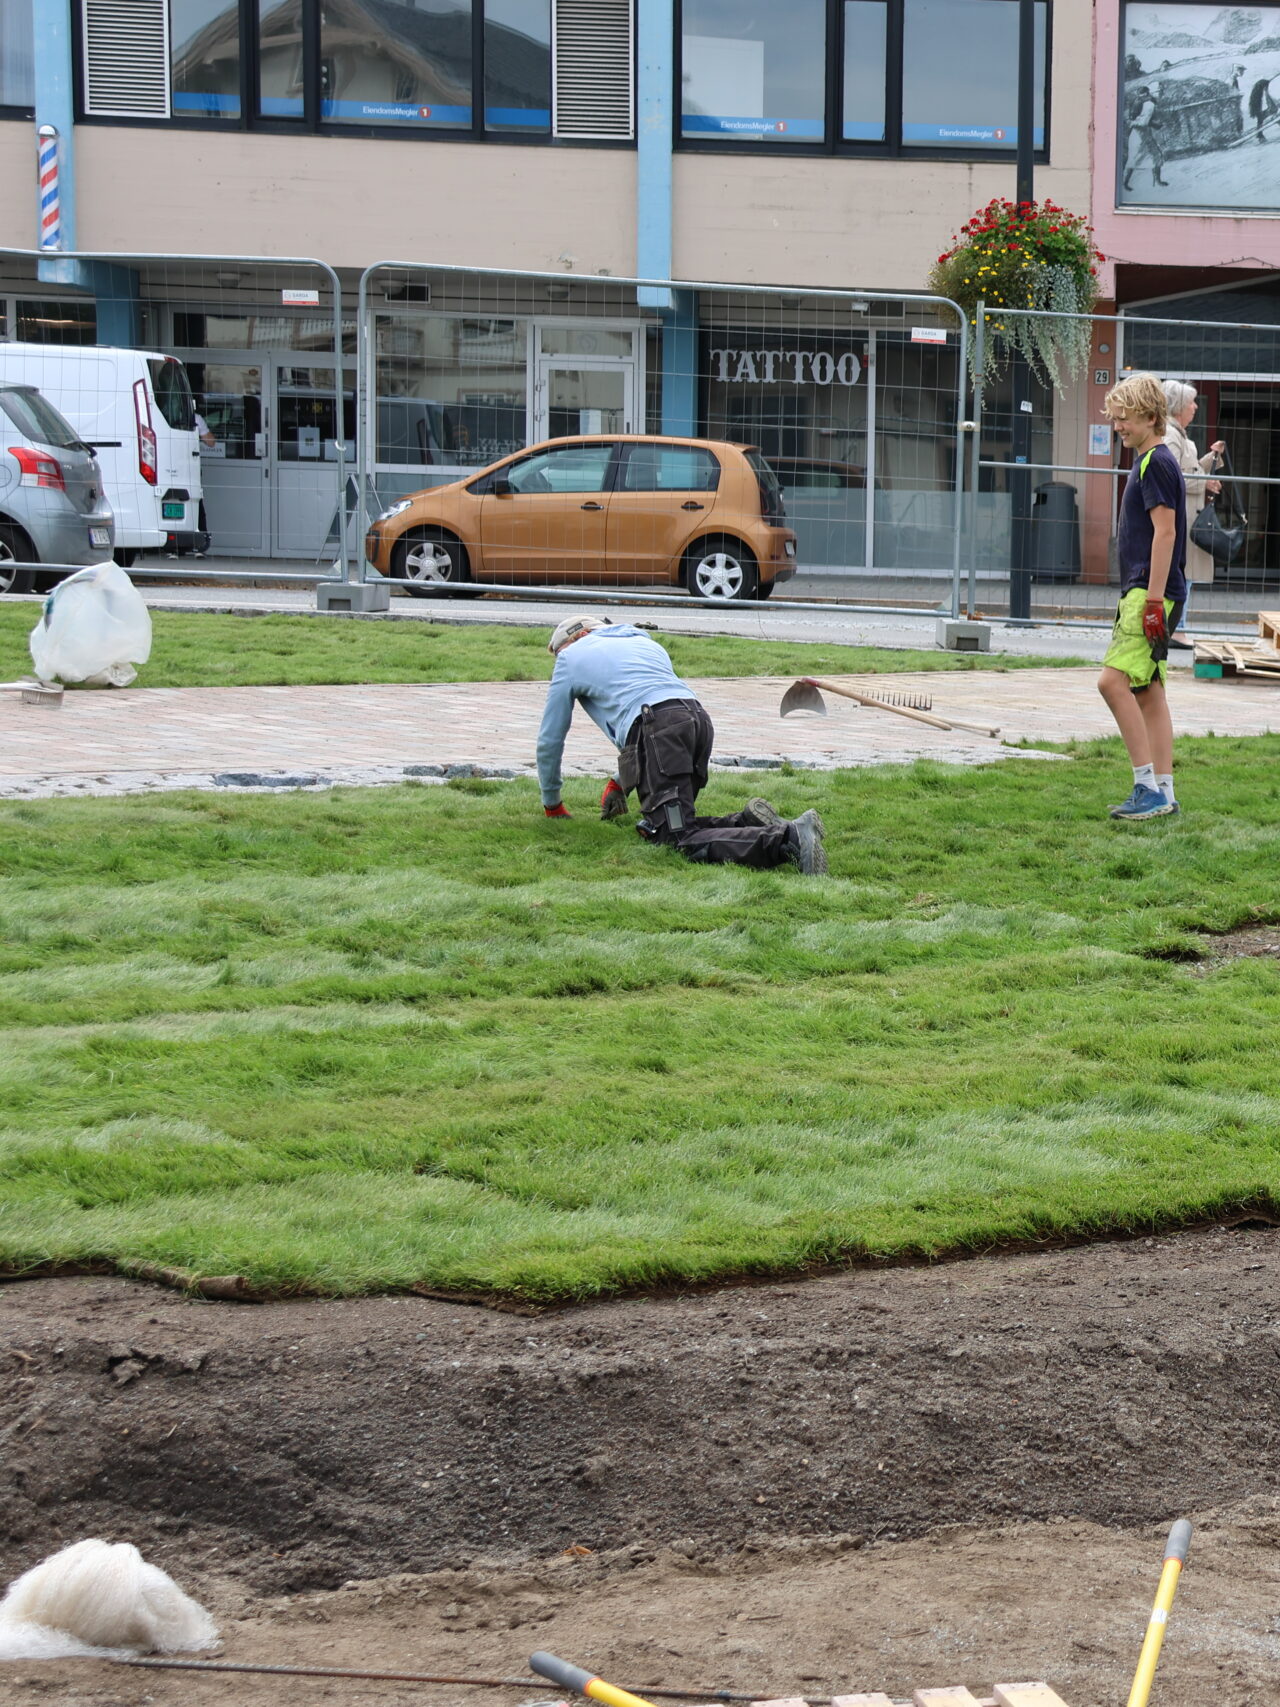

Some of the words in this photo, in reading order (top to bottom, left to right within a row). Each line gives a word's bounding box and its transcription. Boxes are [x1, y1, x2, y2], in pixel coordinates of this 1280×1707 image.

[362, 106, 418, 117] EiendomsMegler
[720, 120, 775, 132] EiendomsMegler
[939, 128, 993, 139] EiendomsMegler
[709, 349, 861, 386] TATTOO
[1096, 371, 1108, 383] 29
